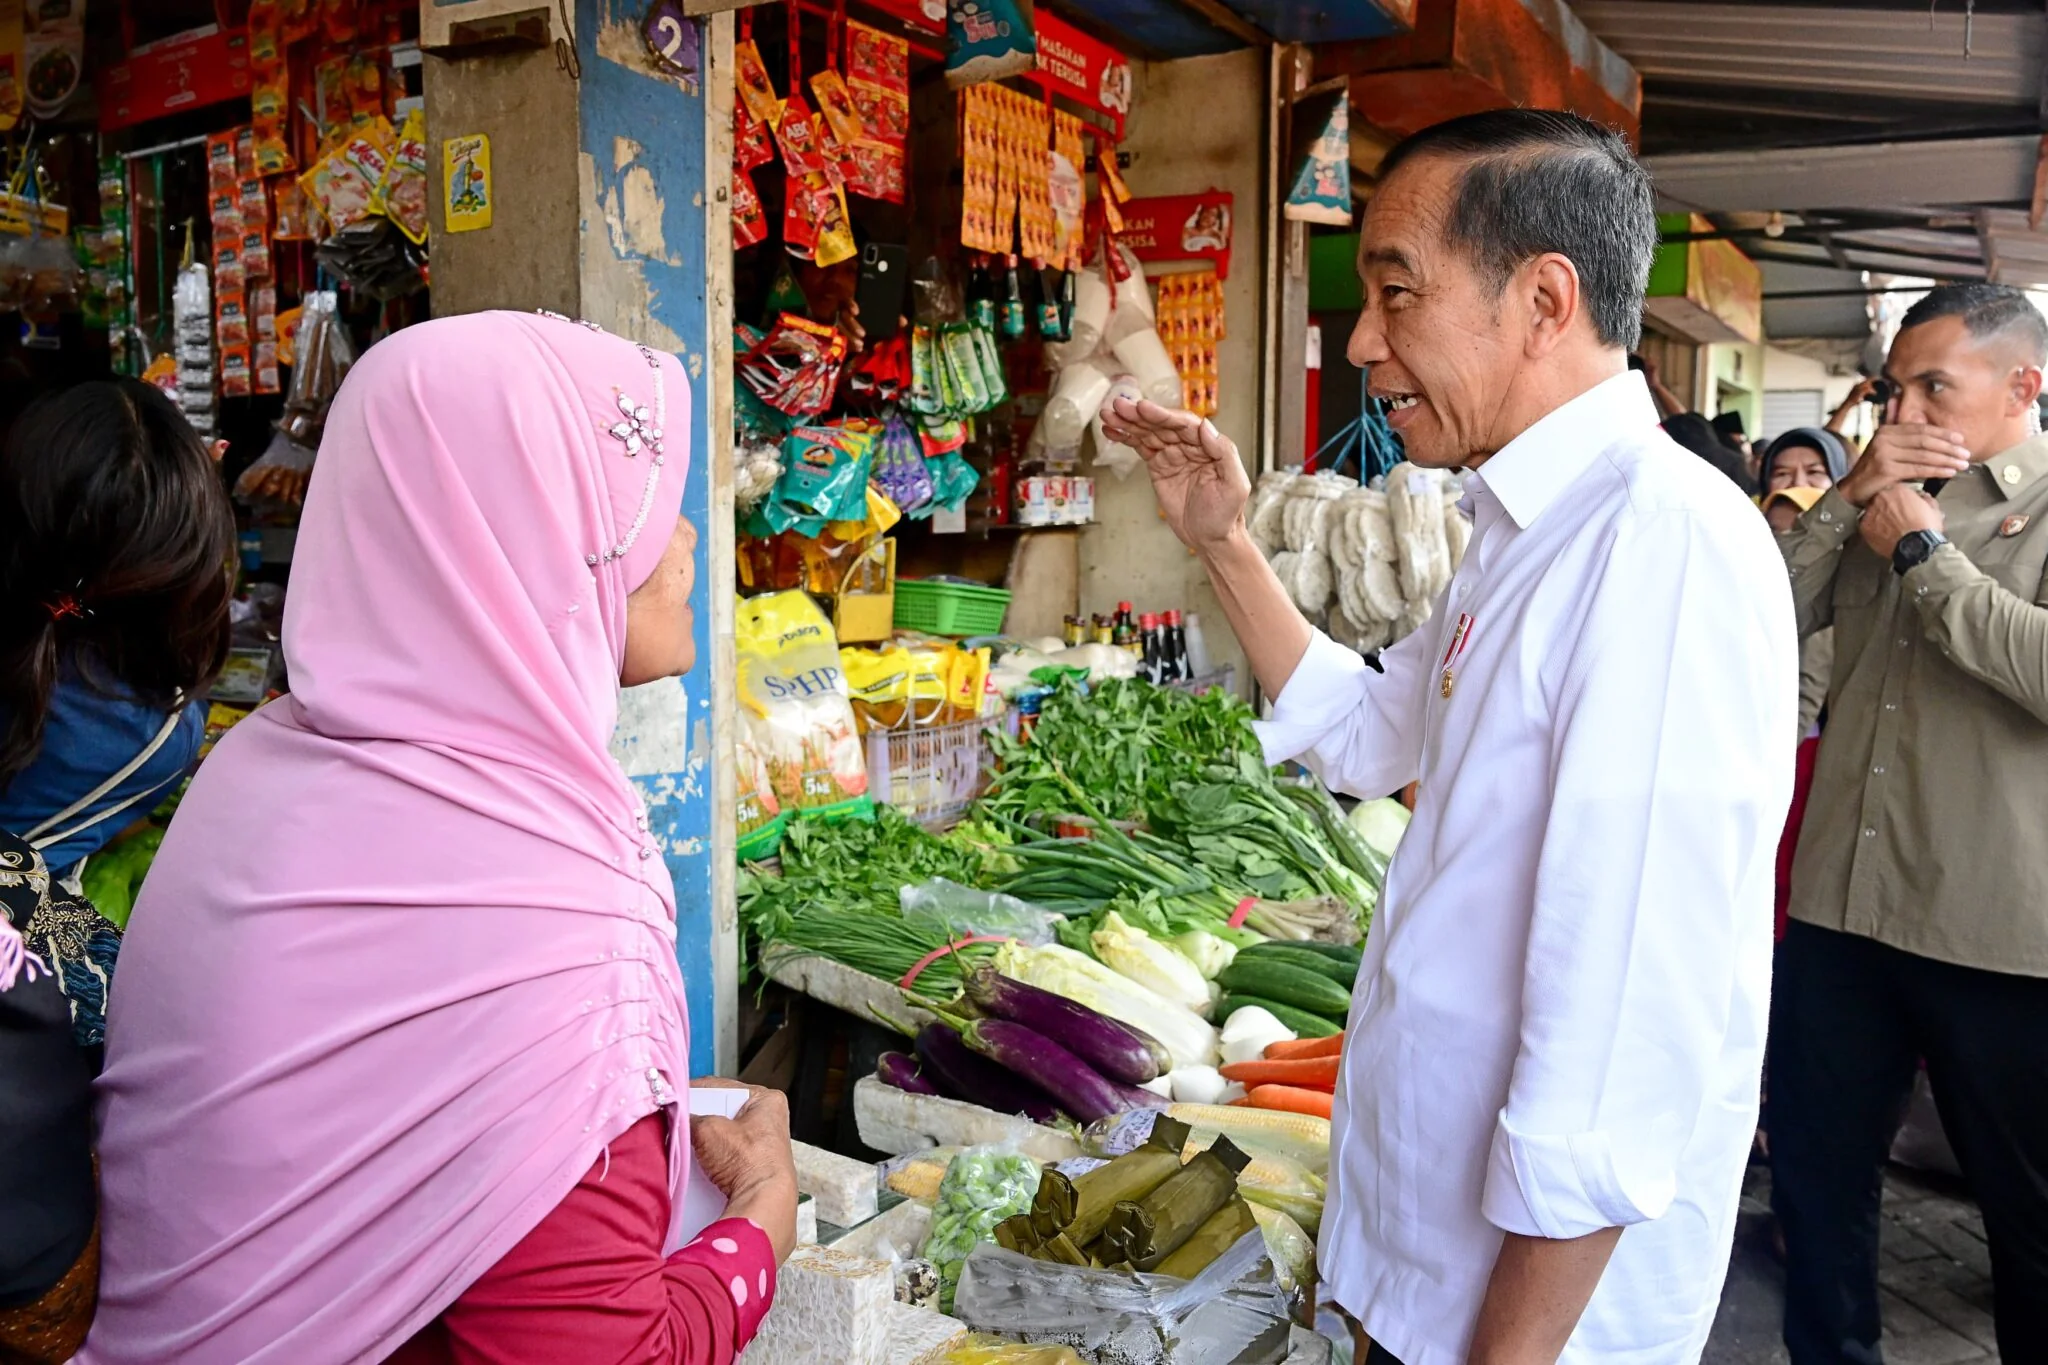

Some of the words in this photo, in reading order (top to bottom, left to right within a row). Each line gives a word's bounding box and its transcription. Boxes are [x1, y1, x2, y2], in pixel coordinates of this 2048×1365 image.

[657, 15, 682, 68] 2
[1039, 36, 1087, 70] MASAKAN
[1123, 217, 1155, 232] KAN
